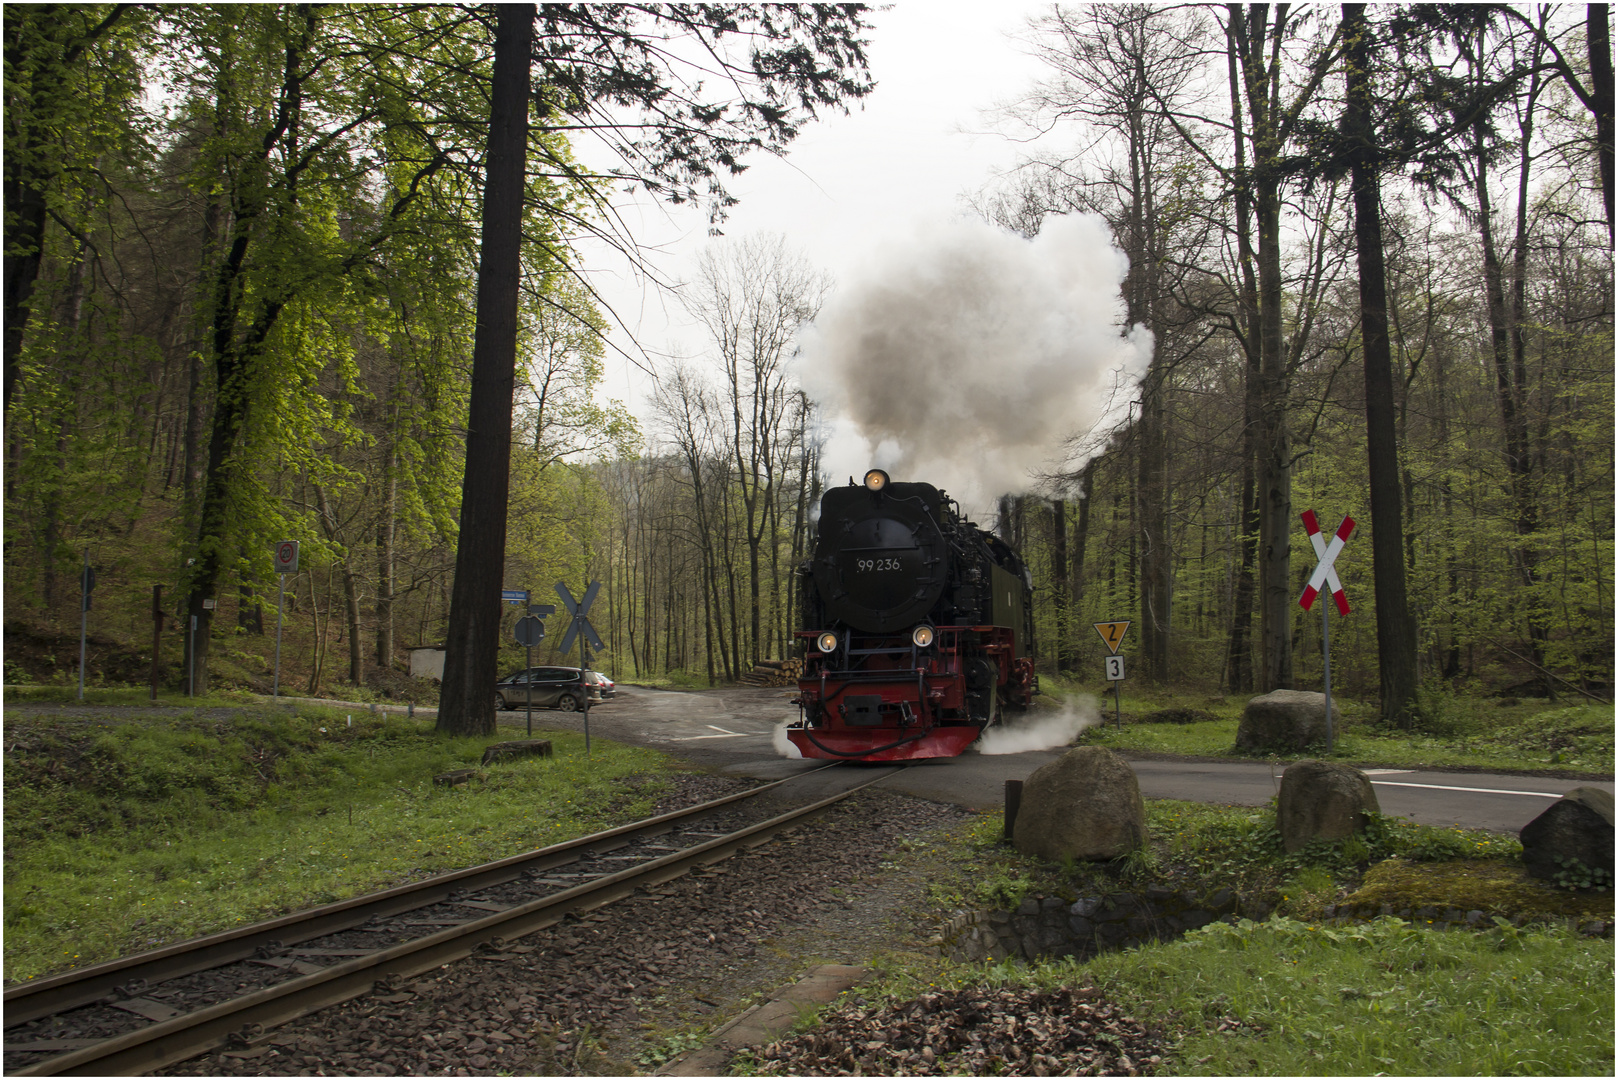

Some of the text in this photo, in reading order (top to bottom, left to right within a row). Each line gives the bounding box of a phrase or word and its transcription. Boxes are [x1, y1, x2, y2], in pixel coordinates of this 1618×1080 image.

[281, 548, 290, 559] 20
[858, 558, 900, 572] 99 236
[1108, 623, 1117, 642] 2
[1110, 659, 1119, 677] 3
